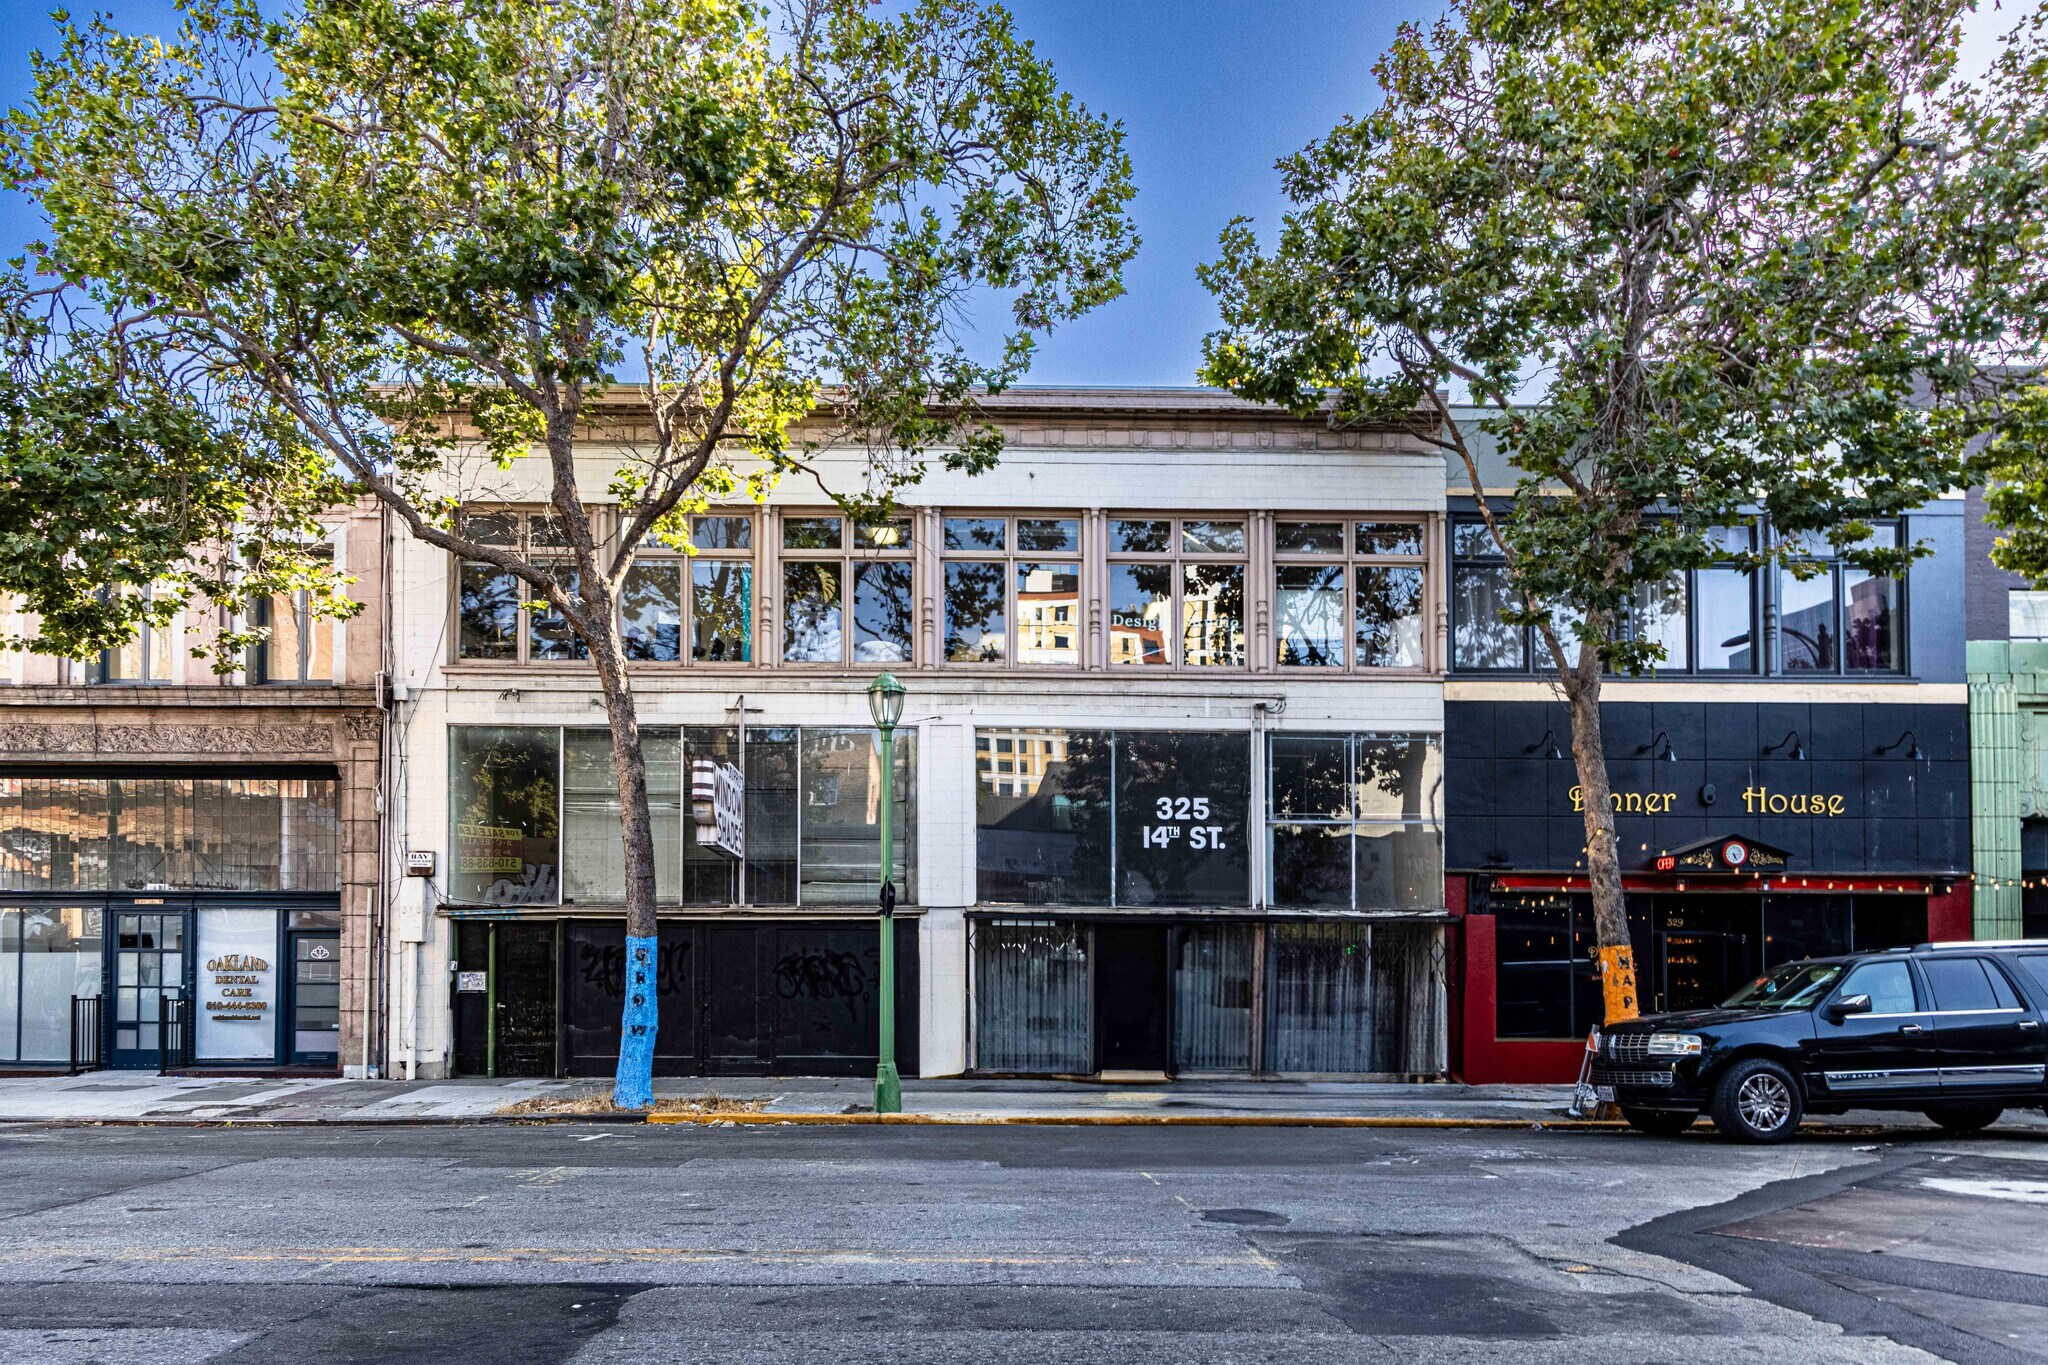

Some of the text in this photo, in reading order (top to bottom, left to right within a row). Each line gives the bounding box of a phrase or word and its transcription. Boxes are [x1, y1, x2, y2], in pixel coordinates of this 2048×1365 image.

[1156, 797, 1210, 820] 325
[1742, 786, 1846, 817] House
[718, 811, 743, 855] SHADES
[1189, 826, 1226, 849] ST.
[1657, 857, 1675, 870] OPEN
[1666, 918, 1684, 927] 329
[206, 954, 268, 971] OAKLAND
[215, 975, 260, 985] DENTAL
[221, 988, 252, 997] CARE
